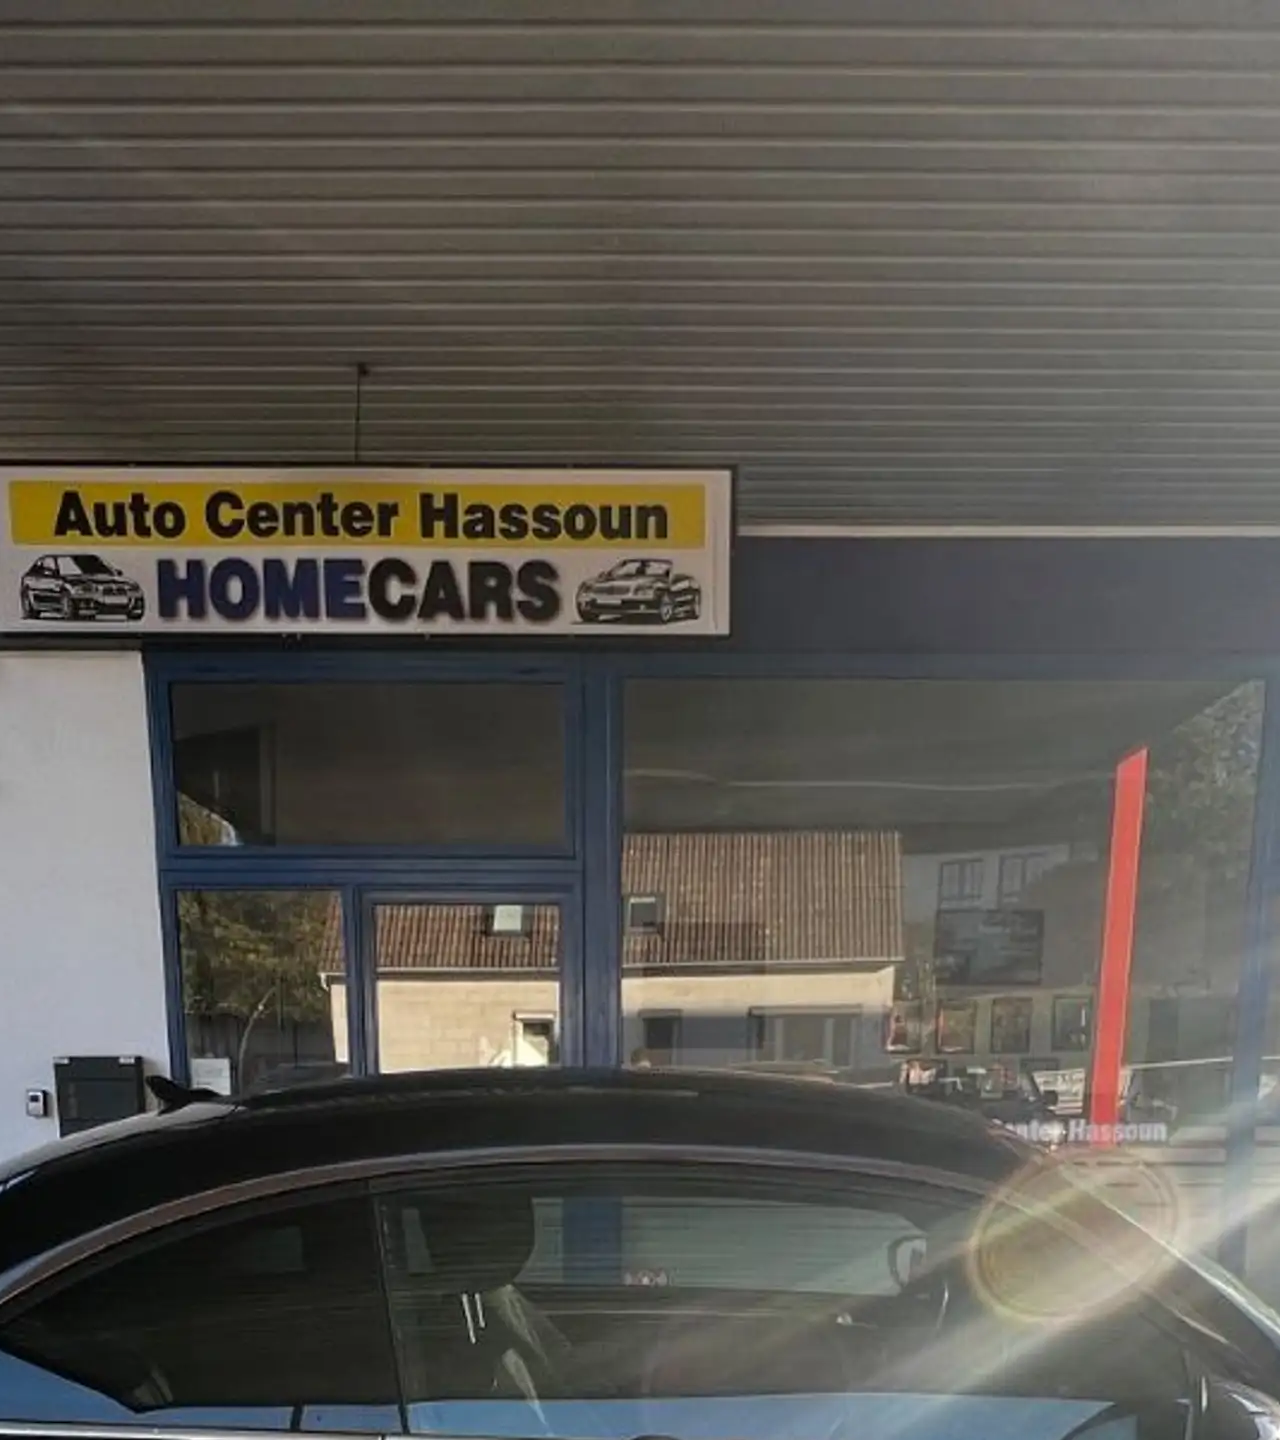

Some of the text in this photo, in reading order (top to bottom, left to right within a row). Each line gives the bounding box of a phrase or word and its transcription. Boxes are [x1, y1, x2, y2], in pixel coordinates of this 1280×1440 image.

[53, 490, 669, 540] Auto Center Hassoun
[157, 558, 560, 621] HOMECARS
